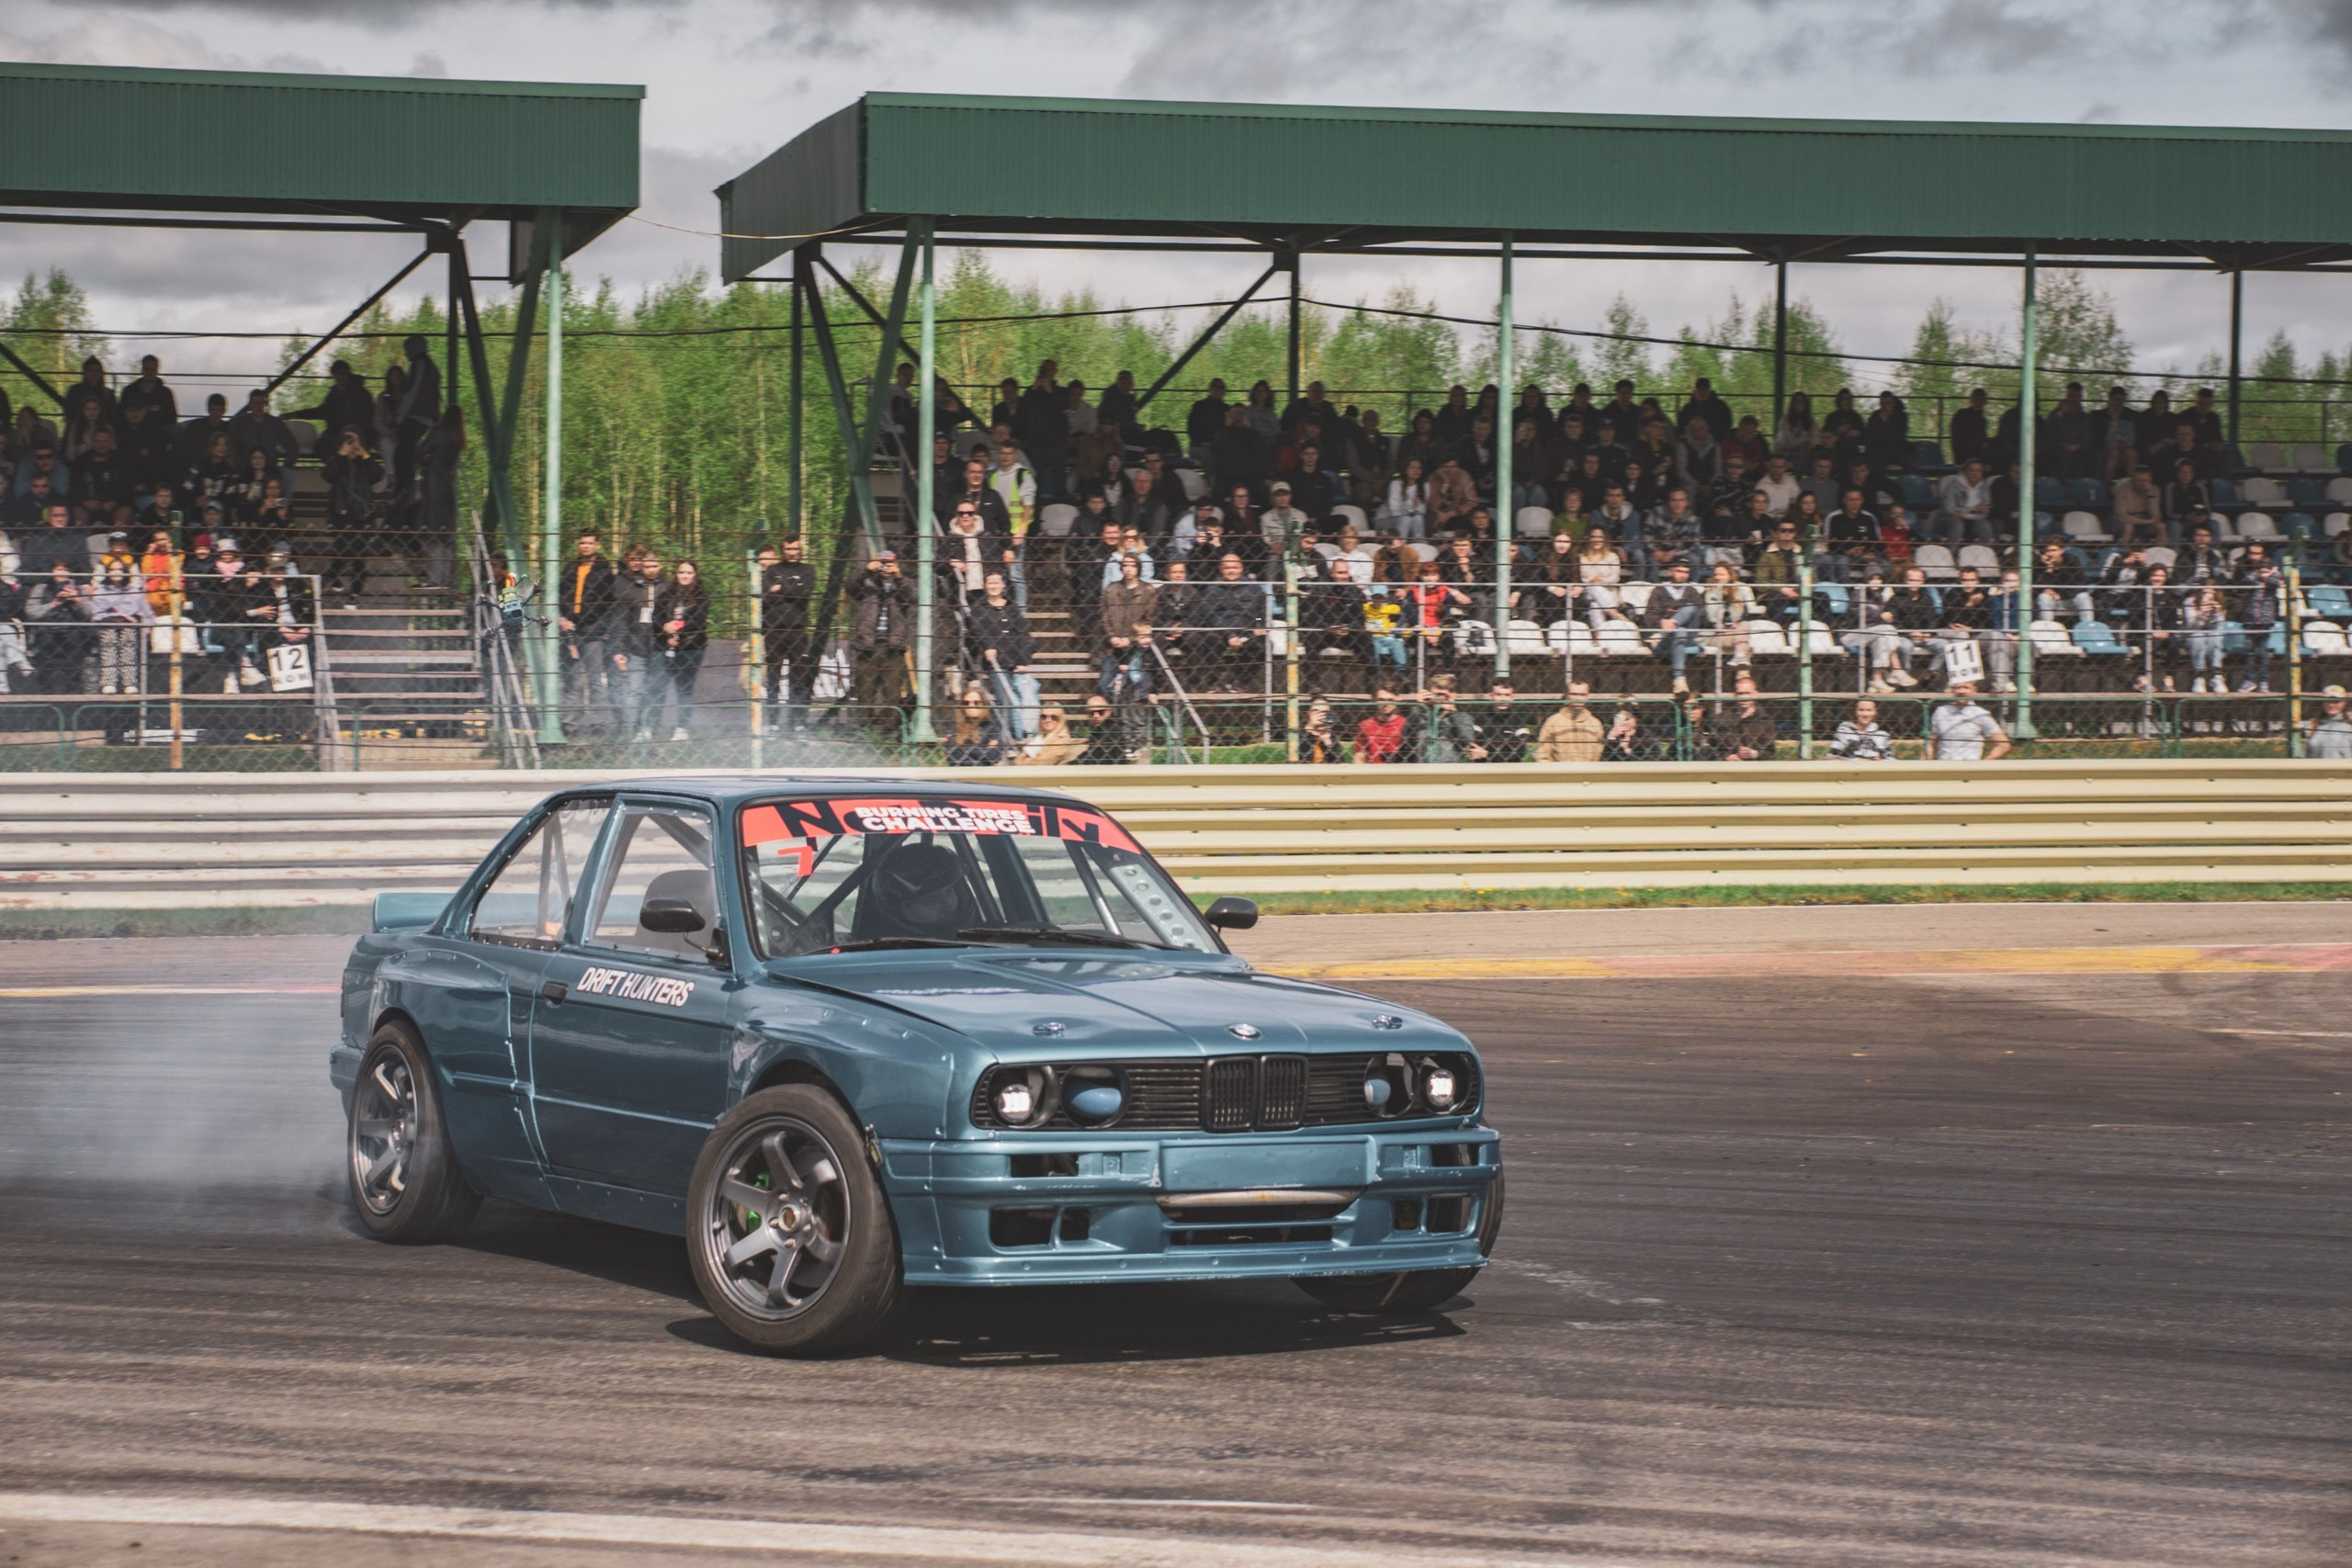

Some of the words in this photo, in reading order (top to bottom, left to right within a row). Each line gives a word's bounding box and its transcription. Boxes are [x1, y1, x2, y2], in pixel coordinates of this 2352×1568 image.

[269, 648, 304, 671] 12
[1947, 643, 1974, 665] 11
[854, 807, 960, 818] BURNING
[961, 807, 1026, 820] TIRES
[862, 817, 1036, 834] CHALLENGE
[576, 966, 628, 996] DRIFT
[617, 972, 695, 1007] HUNTERS
